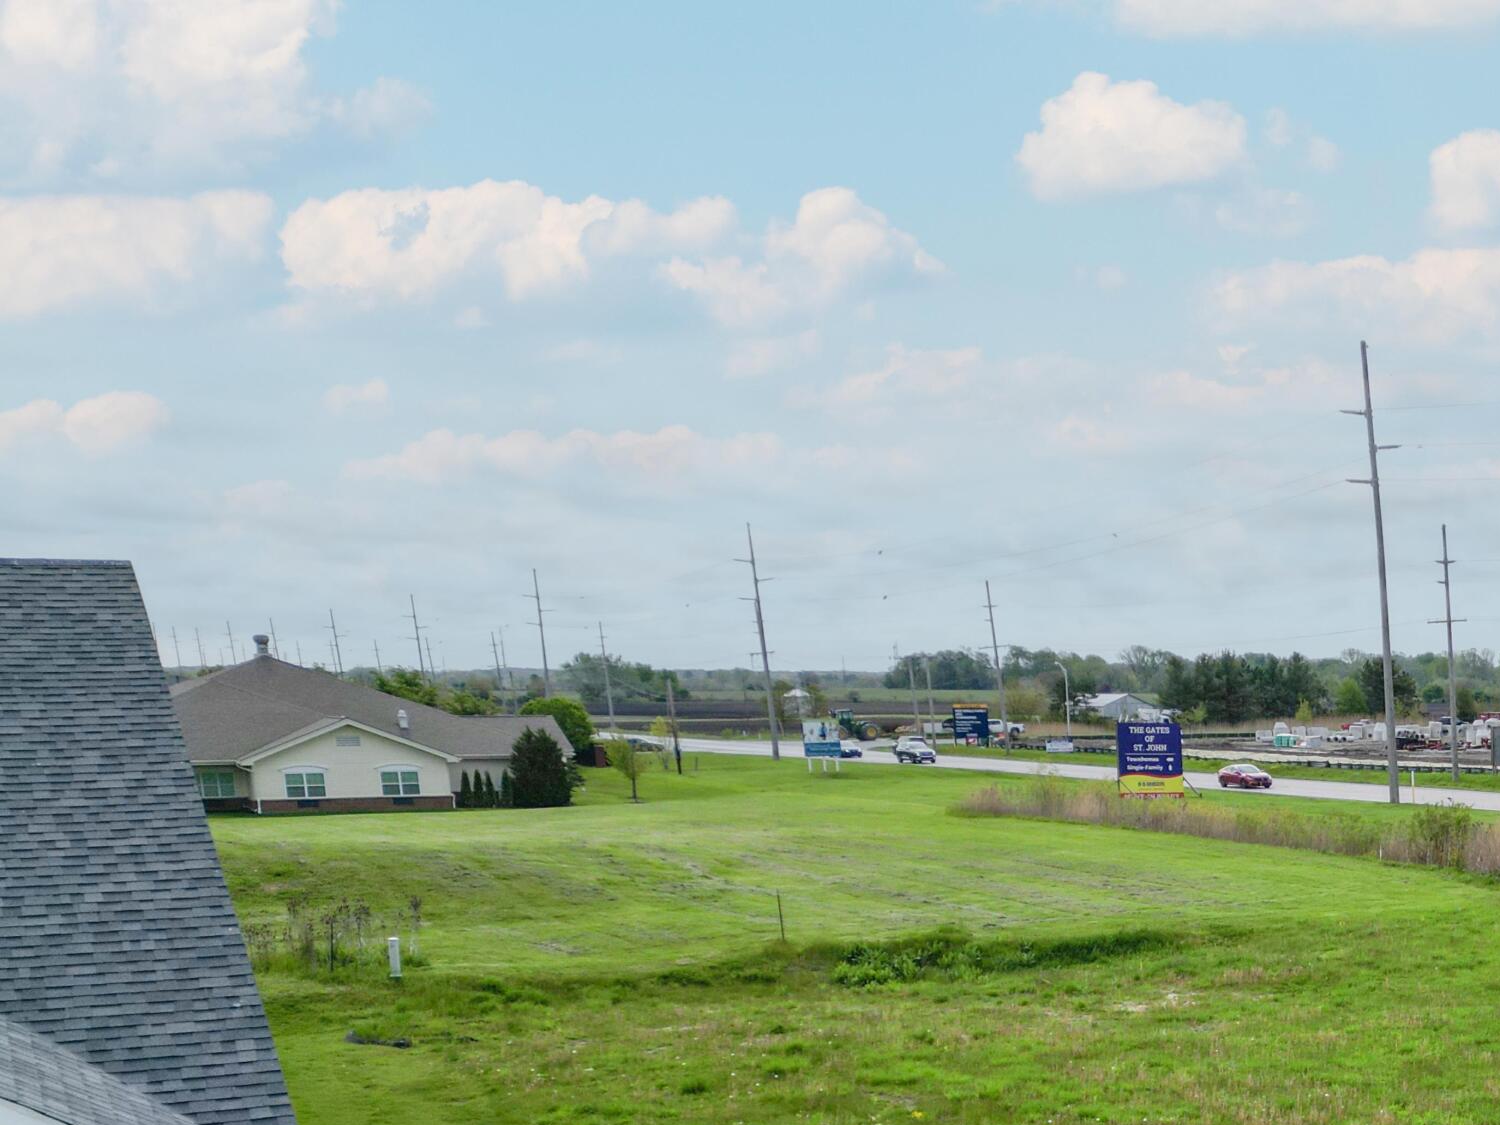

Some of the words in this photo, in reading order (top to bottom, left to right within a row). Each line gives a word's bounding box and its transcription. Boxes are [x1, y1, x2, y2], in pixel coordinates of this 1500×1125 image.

[1128, 726, 1144, 734] THE
[1145, 726, 1170, 734] GATES
[1144, 735, 1155, 743] OF
